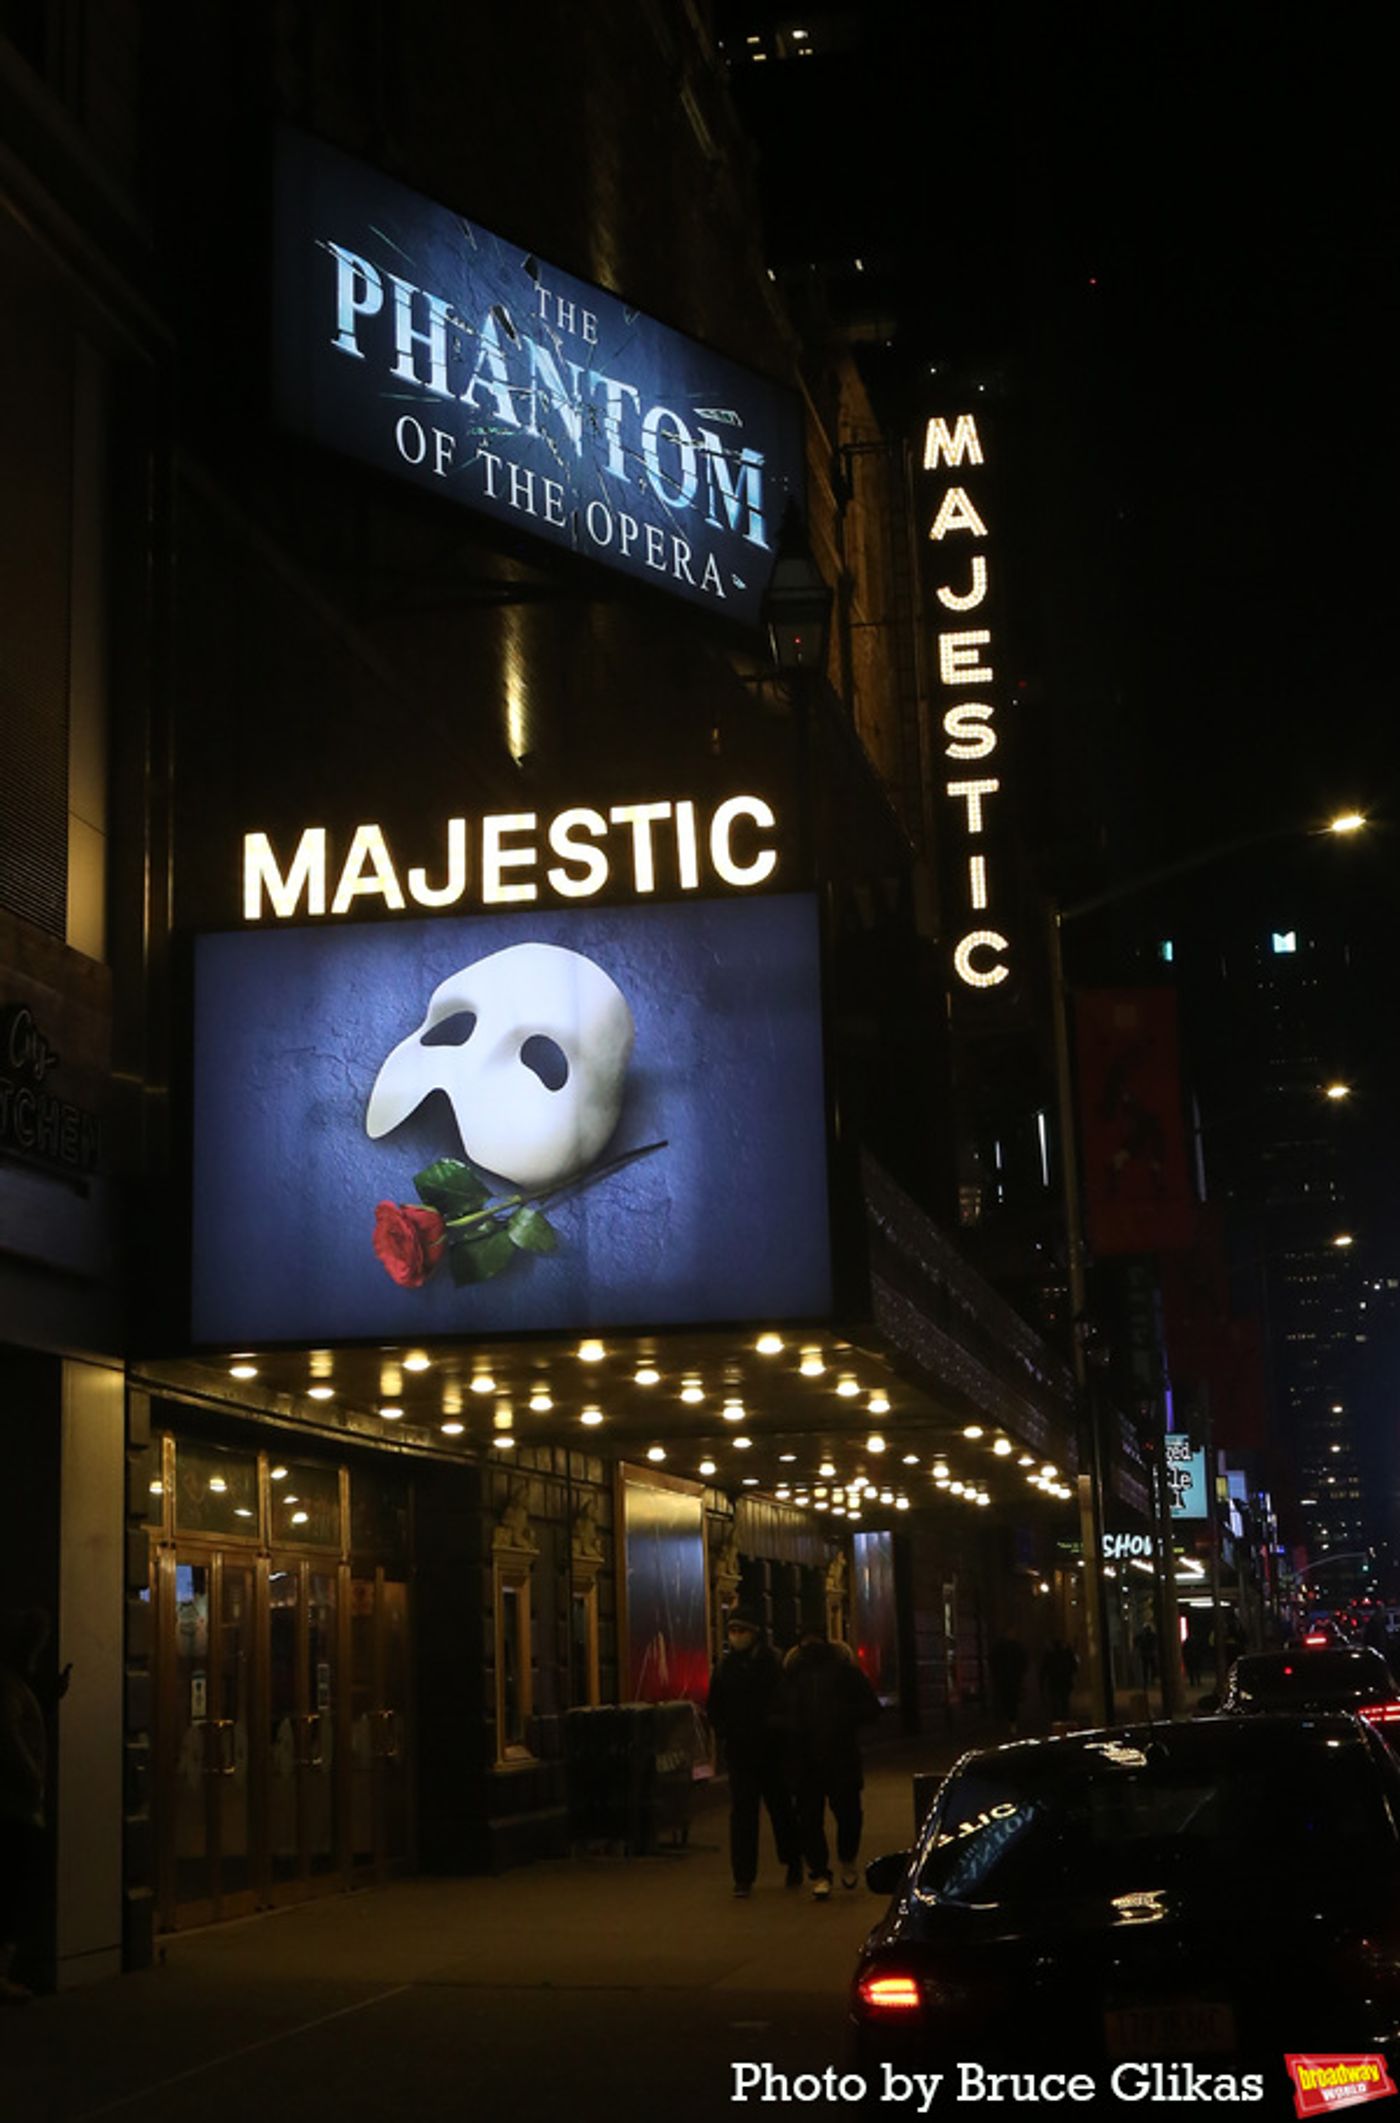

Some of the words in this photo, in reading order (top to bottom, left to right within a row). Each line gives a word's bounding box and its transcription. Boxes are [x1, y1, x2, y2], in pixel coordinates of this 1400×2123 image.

[329, 239, 773, 552] PHANTOM
[532, 280, 600, 346] THE
[395, 414, 456, 479] OF
[477, 447, 567, 529] THE
[586, 500, 728, 600] OPERA
[923, 414, 1010, 988] MAJESTIC
[243, 796, 776, 920] MAJESTIC
